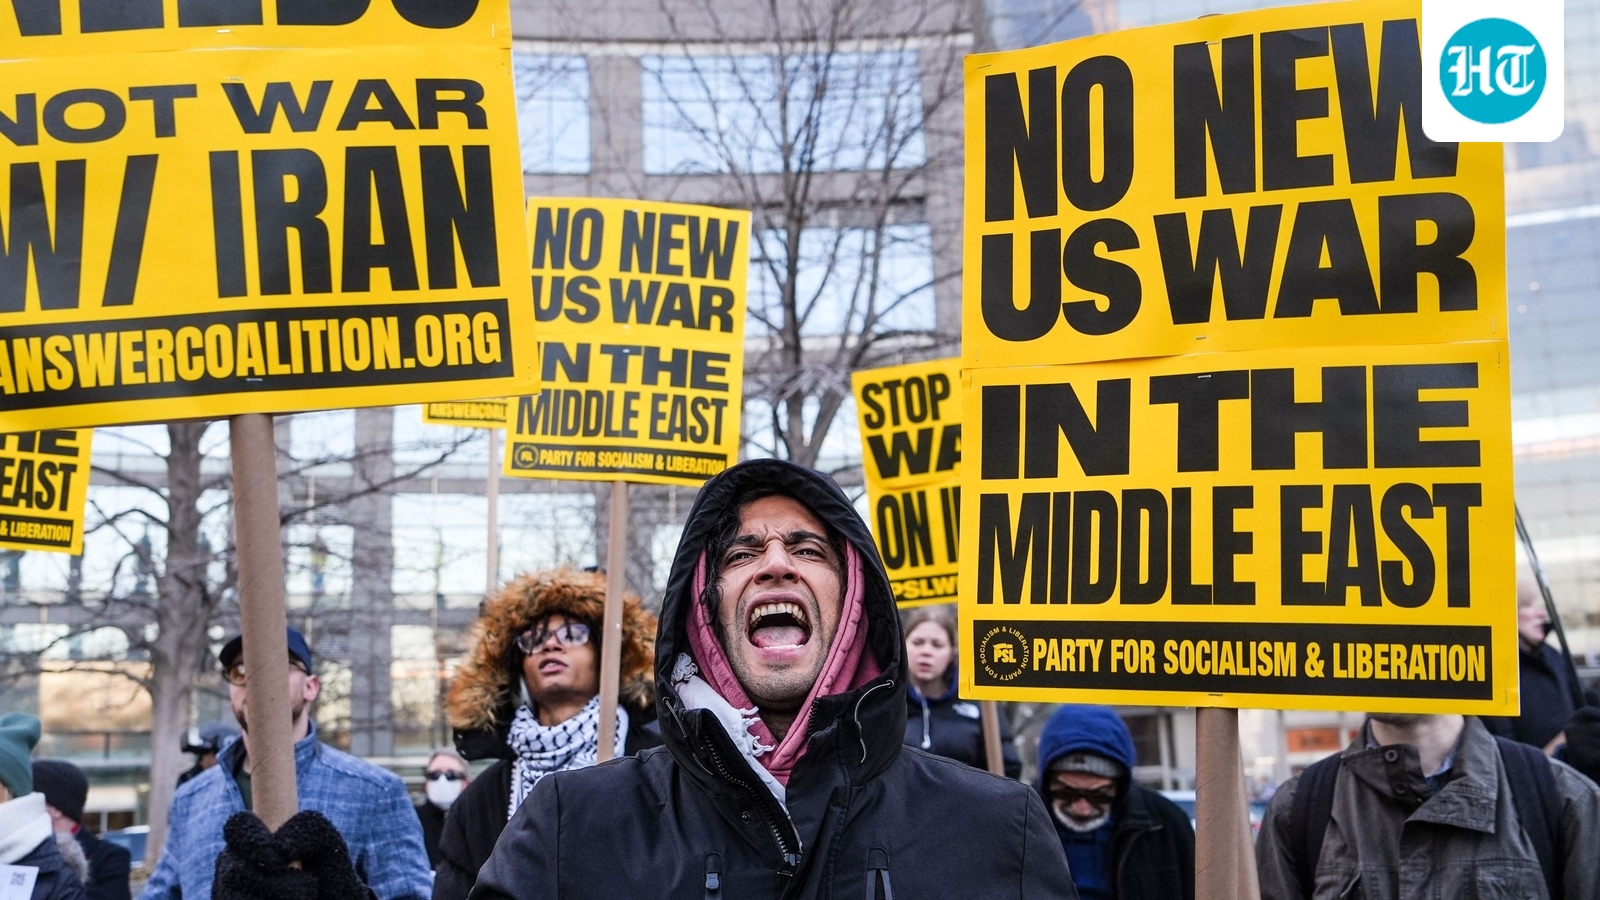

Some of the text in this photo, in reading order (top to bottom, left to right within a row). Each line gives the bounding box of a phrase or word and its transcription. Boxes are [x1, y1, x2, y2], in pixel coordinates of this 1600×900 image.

[0, 79, 488, 146] NOT WAR
[984, 18, 1459, 222] NO NEW
[209, 145, 501, 298] IRAN
[532, 207, 739, 281] NO NEW
[981, 192, 1478, 342] US WAR
[532, 276, 735, 333] US WAR
[0, 312, 501, 394] ANSWERCOALITION.ORG
[537, 342, 730, 391] N THE
[516, 388, 728, 445] MIDDLE EAST
[862, 373, 950, 430] STOP
[981, 362, 1481, 479] IN THE
[0, 457, 77, 512] EAST
[539, 449, 573, 467] PARTY
[575, 450, 596, 468] FOR
[597, 451, 653, 470] SOCIALISM
[655, 457, 665, 471] &
[666, 458, 725, 477] LIBERATION
[10, 520, 71, 542] LIBERATION
[877, 490, 935, 570] ON
[977, 482, 1482, 608] MIDDLE EAST
[980, 627, 1000, 664] SOCIALISM
[1008, 627, 1030, 669] LIBERATION
[984, 665, 1022, 681] PARTY FOR
[993, 646, 1017, 663] PSL
[1032, 637, 1485, 682] PARTY FOR SOCIALISM & LIBERATION
